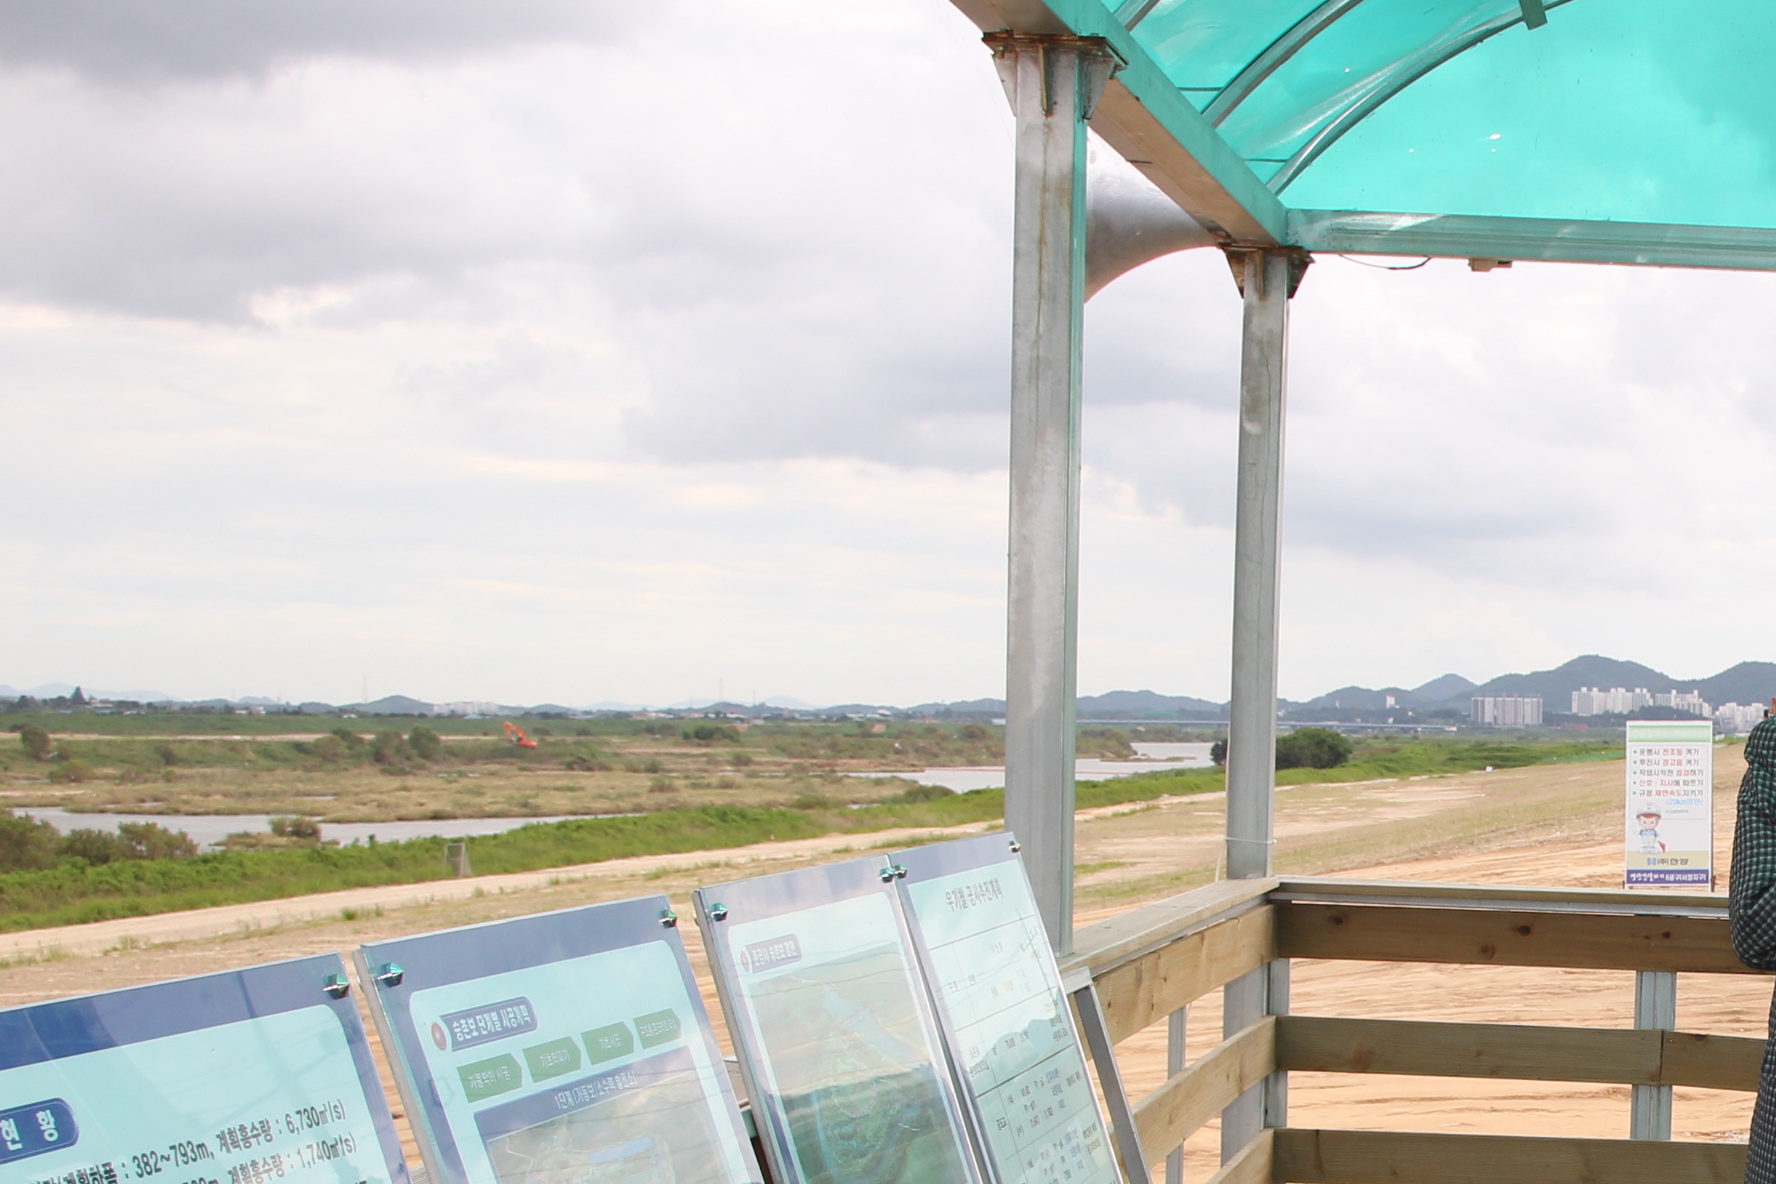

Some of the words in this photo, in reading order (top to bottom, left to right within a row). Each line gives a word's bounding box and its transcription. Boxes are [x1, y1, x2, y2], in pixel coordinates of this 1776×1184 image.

[452, 1016, 479, 1042] 승촌보
[475, 1011, 503, 1035] 단계별
[499, 1004, 532, 1028] 시공계획
[35, 1109, 59, 1142] 황
[131, 1140, 215, 1179] 382~793m,
[215, 1117, 274, 1155] 계획홍수량
